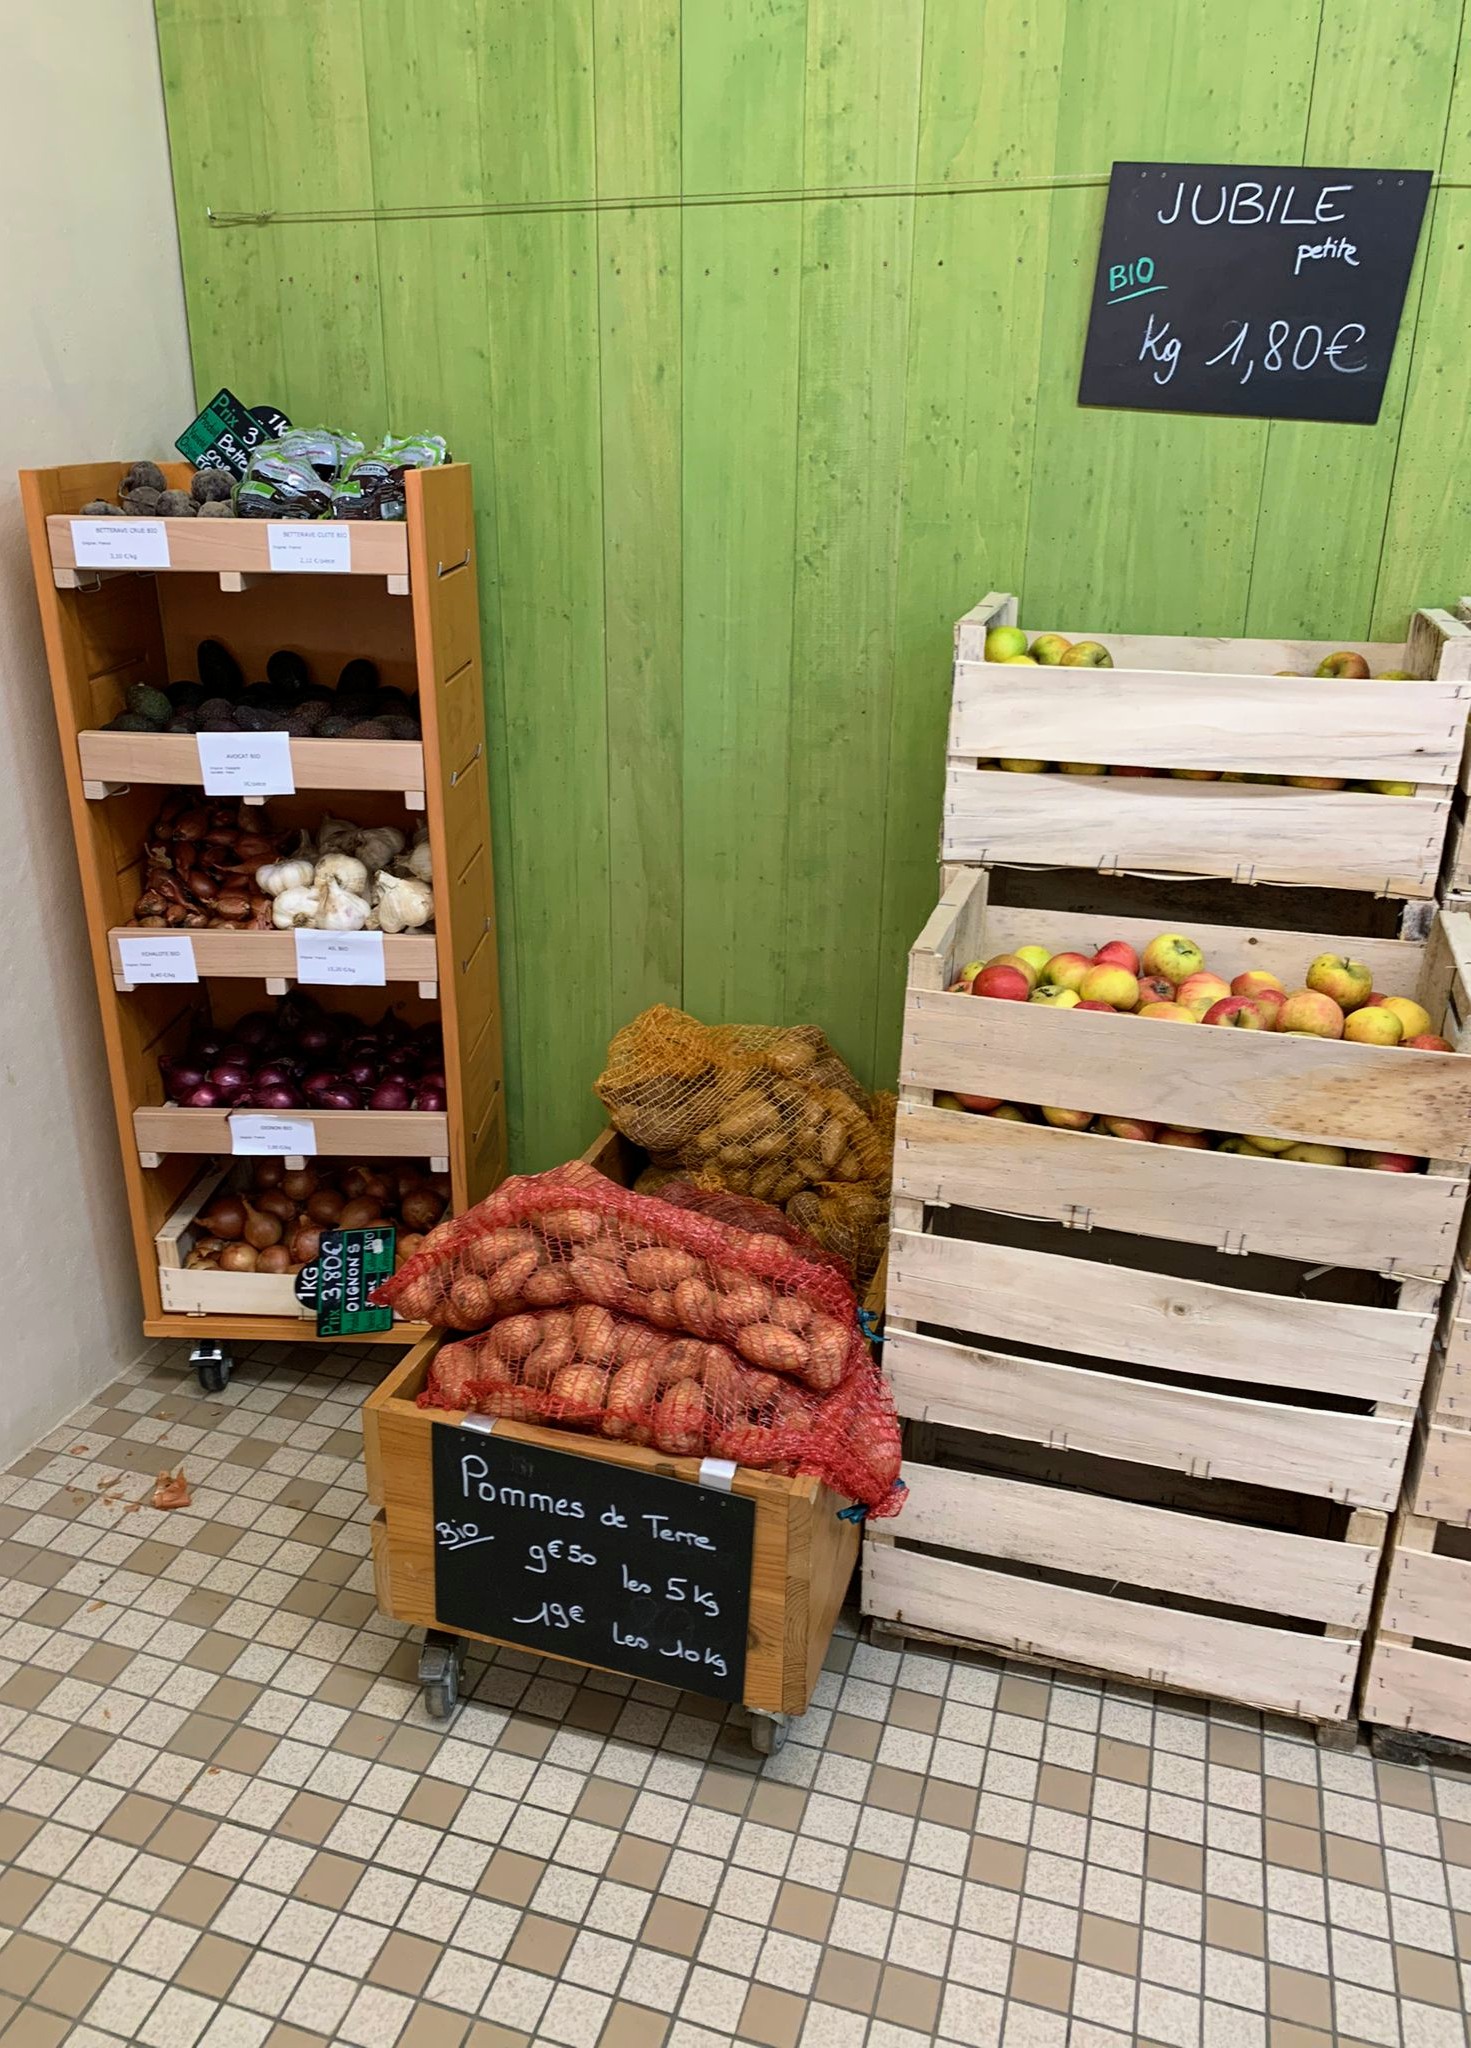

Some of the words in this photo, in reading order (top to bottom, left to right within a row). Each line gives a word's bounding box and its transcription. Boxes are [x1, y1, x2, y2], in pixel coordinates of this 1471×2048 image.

[1157, 182, 1354, 225] JUBILE
[1109, 256, 1155, 292] BIO
[1294, 236, 1360, 275] petite
[1205, 320, 1367, 384] 1,80€
[212, 393, 239, 427] Prix
[217, 433, 248, 473] Bette
[296, 1267, 319, 1300] 1KG
[321, 1241, 344, 1300] 3,80€
[320, 1309, 340, 1335] Prix
[460, 1454, 585, 1519] Pommes
[600, 1504, 628, 1529] de
[642, 1514, 717, 1551] Terre
[435, 1519, 479, 1545] Bio
[524, 1539, 597, 1574] 9€50
[621, 1564, 652, 1594] les
[512, 1602, 587, 1629] 19€
